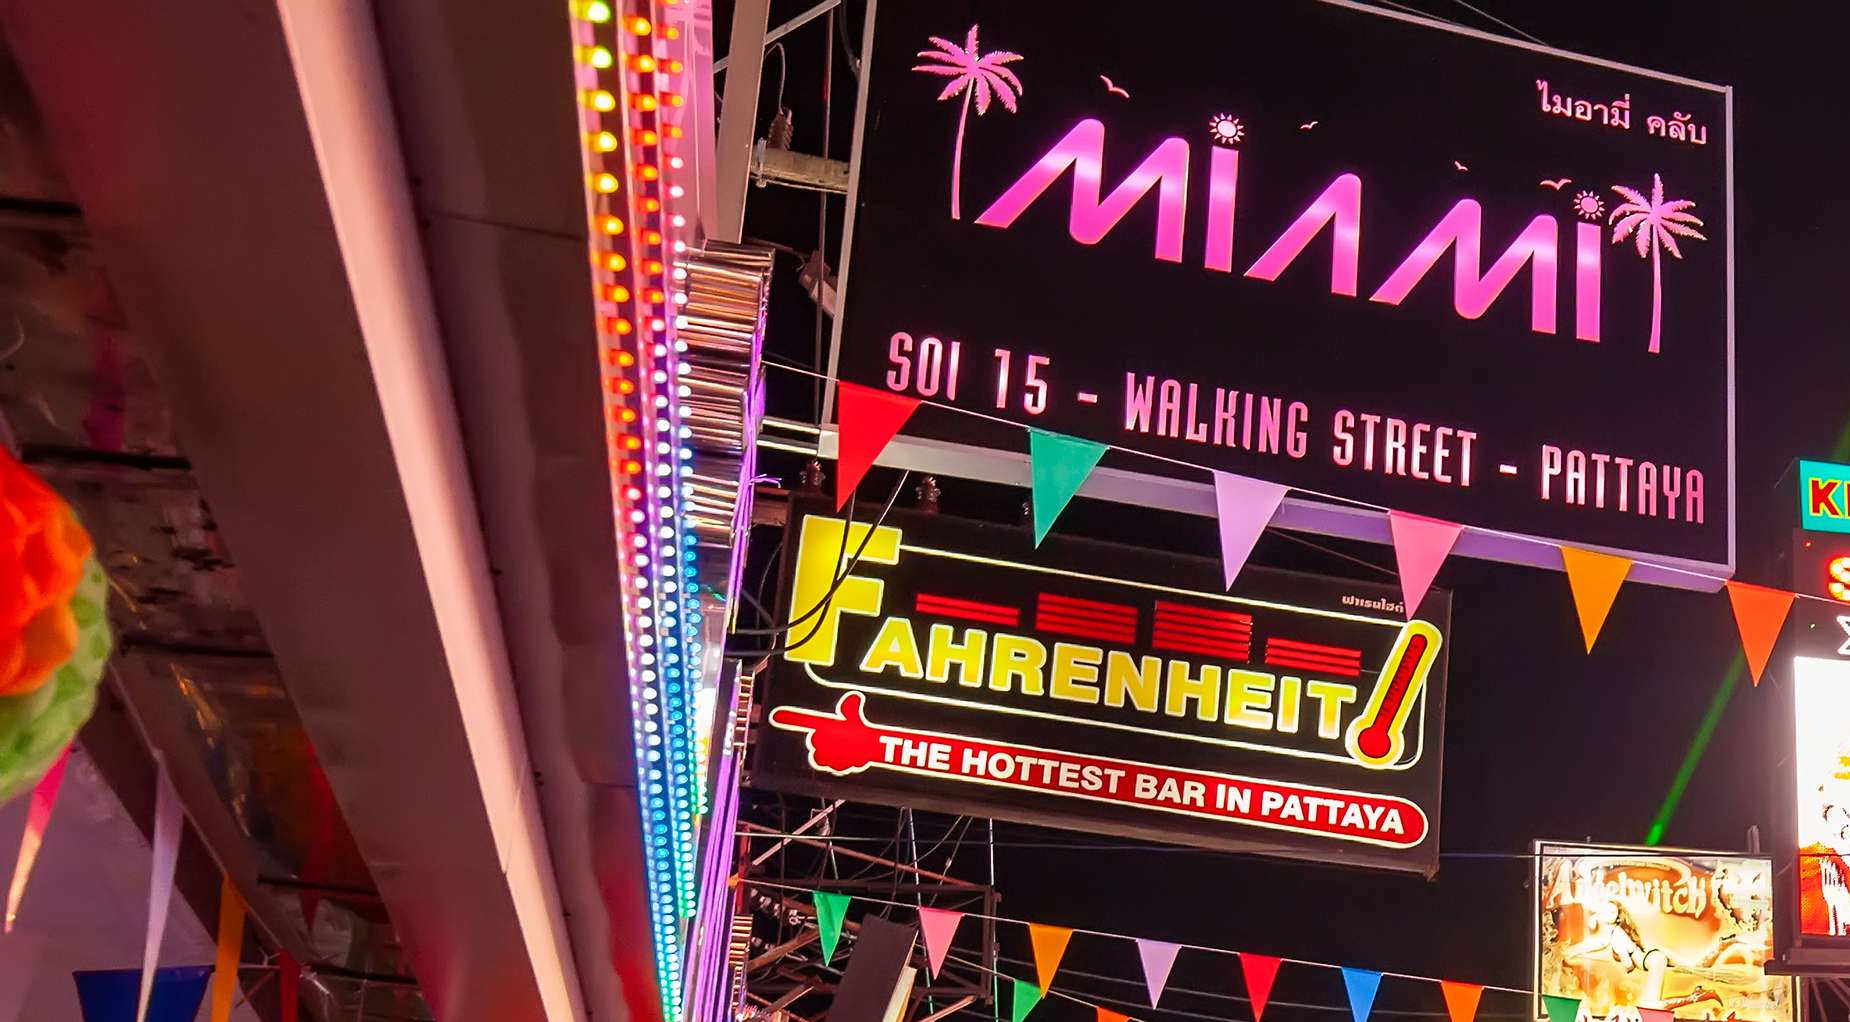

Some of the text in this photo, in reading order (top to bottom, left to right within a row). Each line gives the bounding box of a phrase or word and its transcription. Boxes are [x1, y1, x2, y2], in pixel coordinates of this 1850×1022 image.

[1536, 79, 1707, 145] ไมอามี่ คลับ
[886, 330, 961, 400] SOI
[993, 347, 1051, 414] 15
[1124, 371, 1310, 460] WALKING
[1332, 410, 1475, 488] STREET
[1541, 444, 1707, 525] PATTAYA
[784, 514, 1357, 742] FAHRENHEIT
[879, 734, 1405, 836] THE HOTTEST BAR IN PATTAYA
